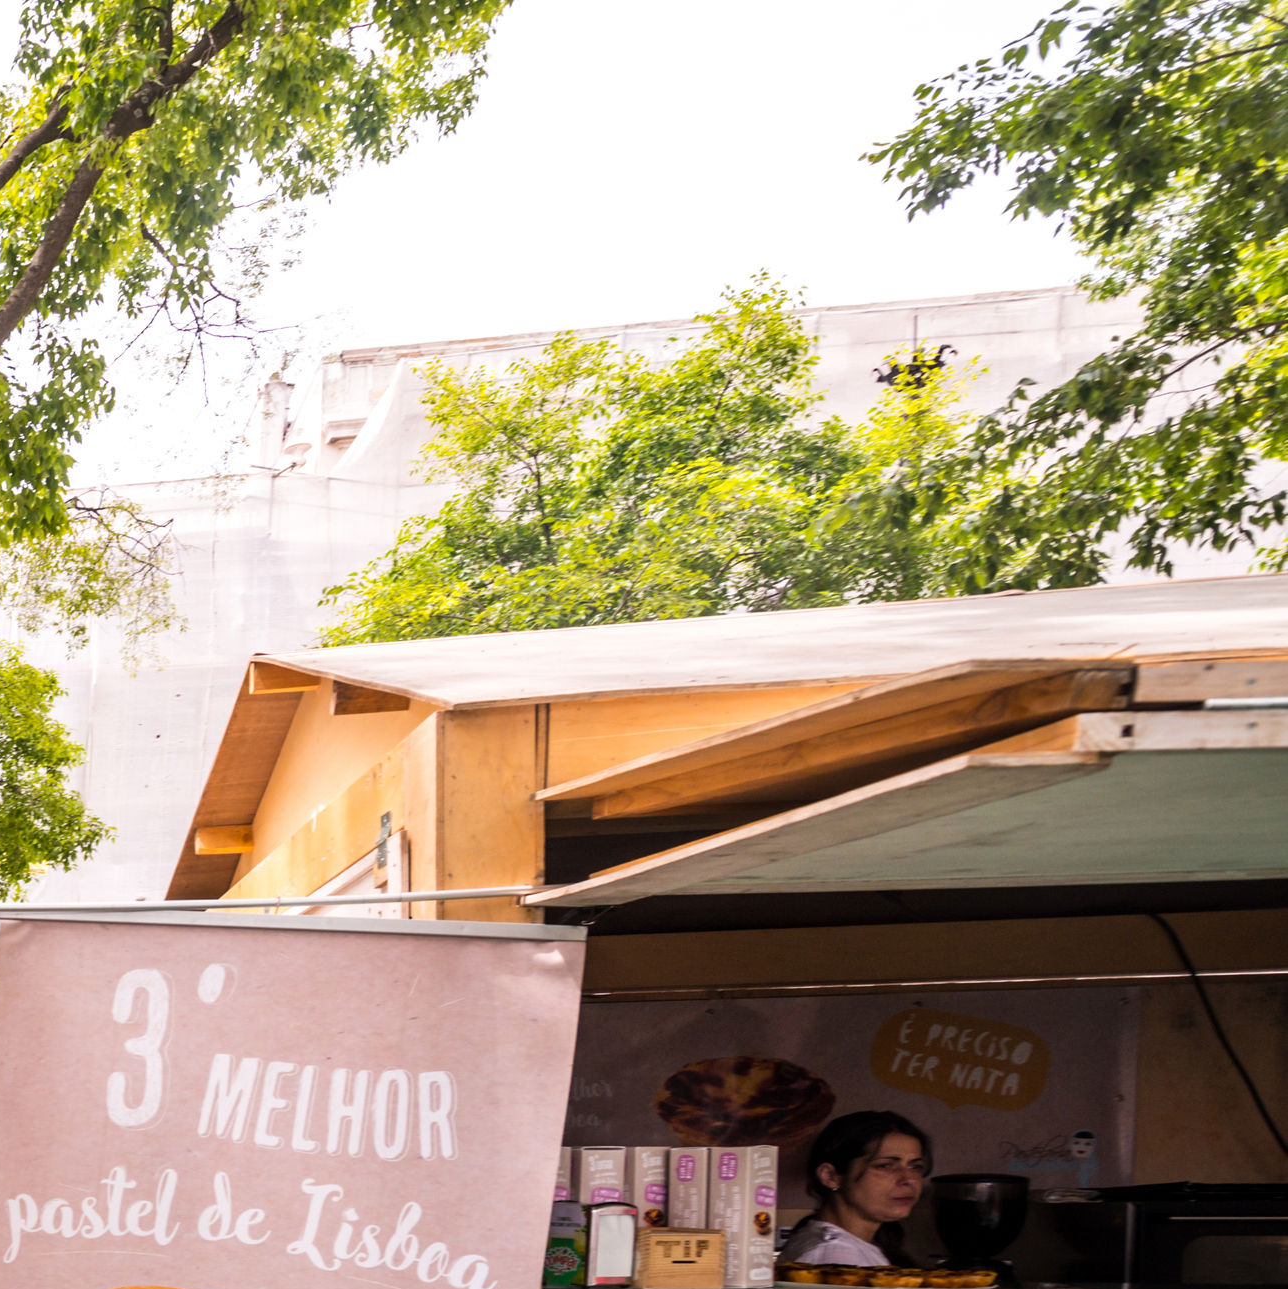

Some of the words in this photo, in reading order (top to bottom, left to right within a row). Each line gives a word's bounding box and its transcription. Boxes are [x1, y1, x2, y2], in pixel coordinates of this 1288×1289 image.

[891, 1048, 940, 1081] TER
[949, 1063, 1021, 1096] NATA
[898, 1013, 915, 1044] É
[925, 1023, 1033, 1065] PRECISO
[197, 1053, 458, 1160] MELHOR
[2, 1165, 181, 1264] pastel
[196, 1171, 272, 1243] de
